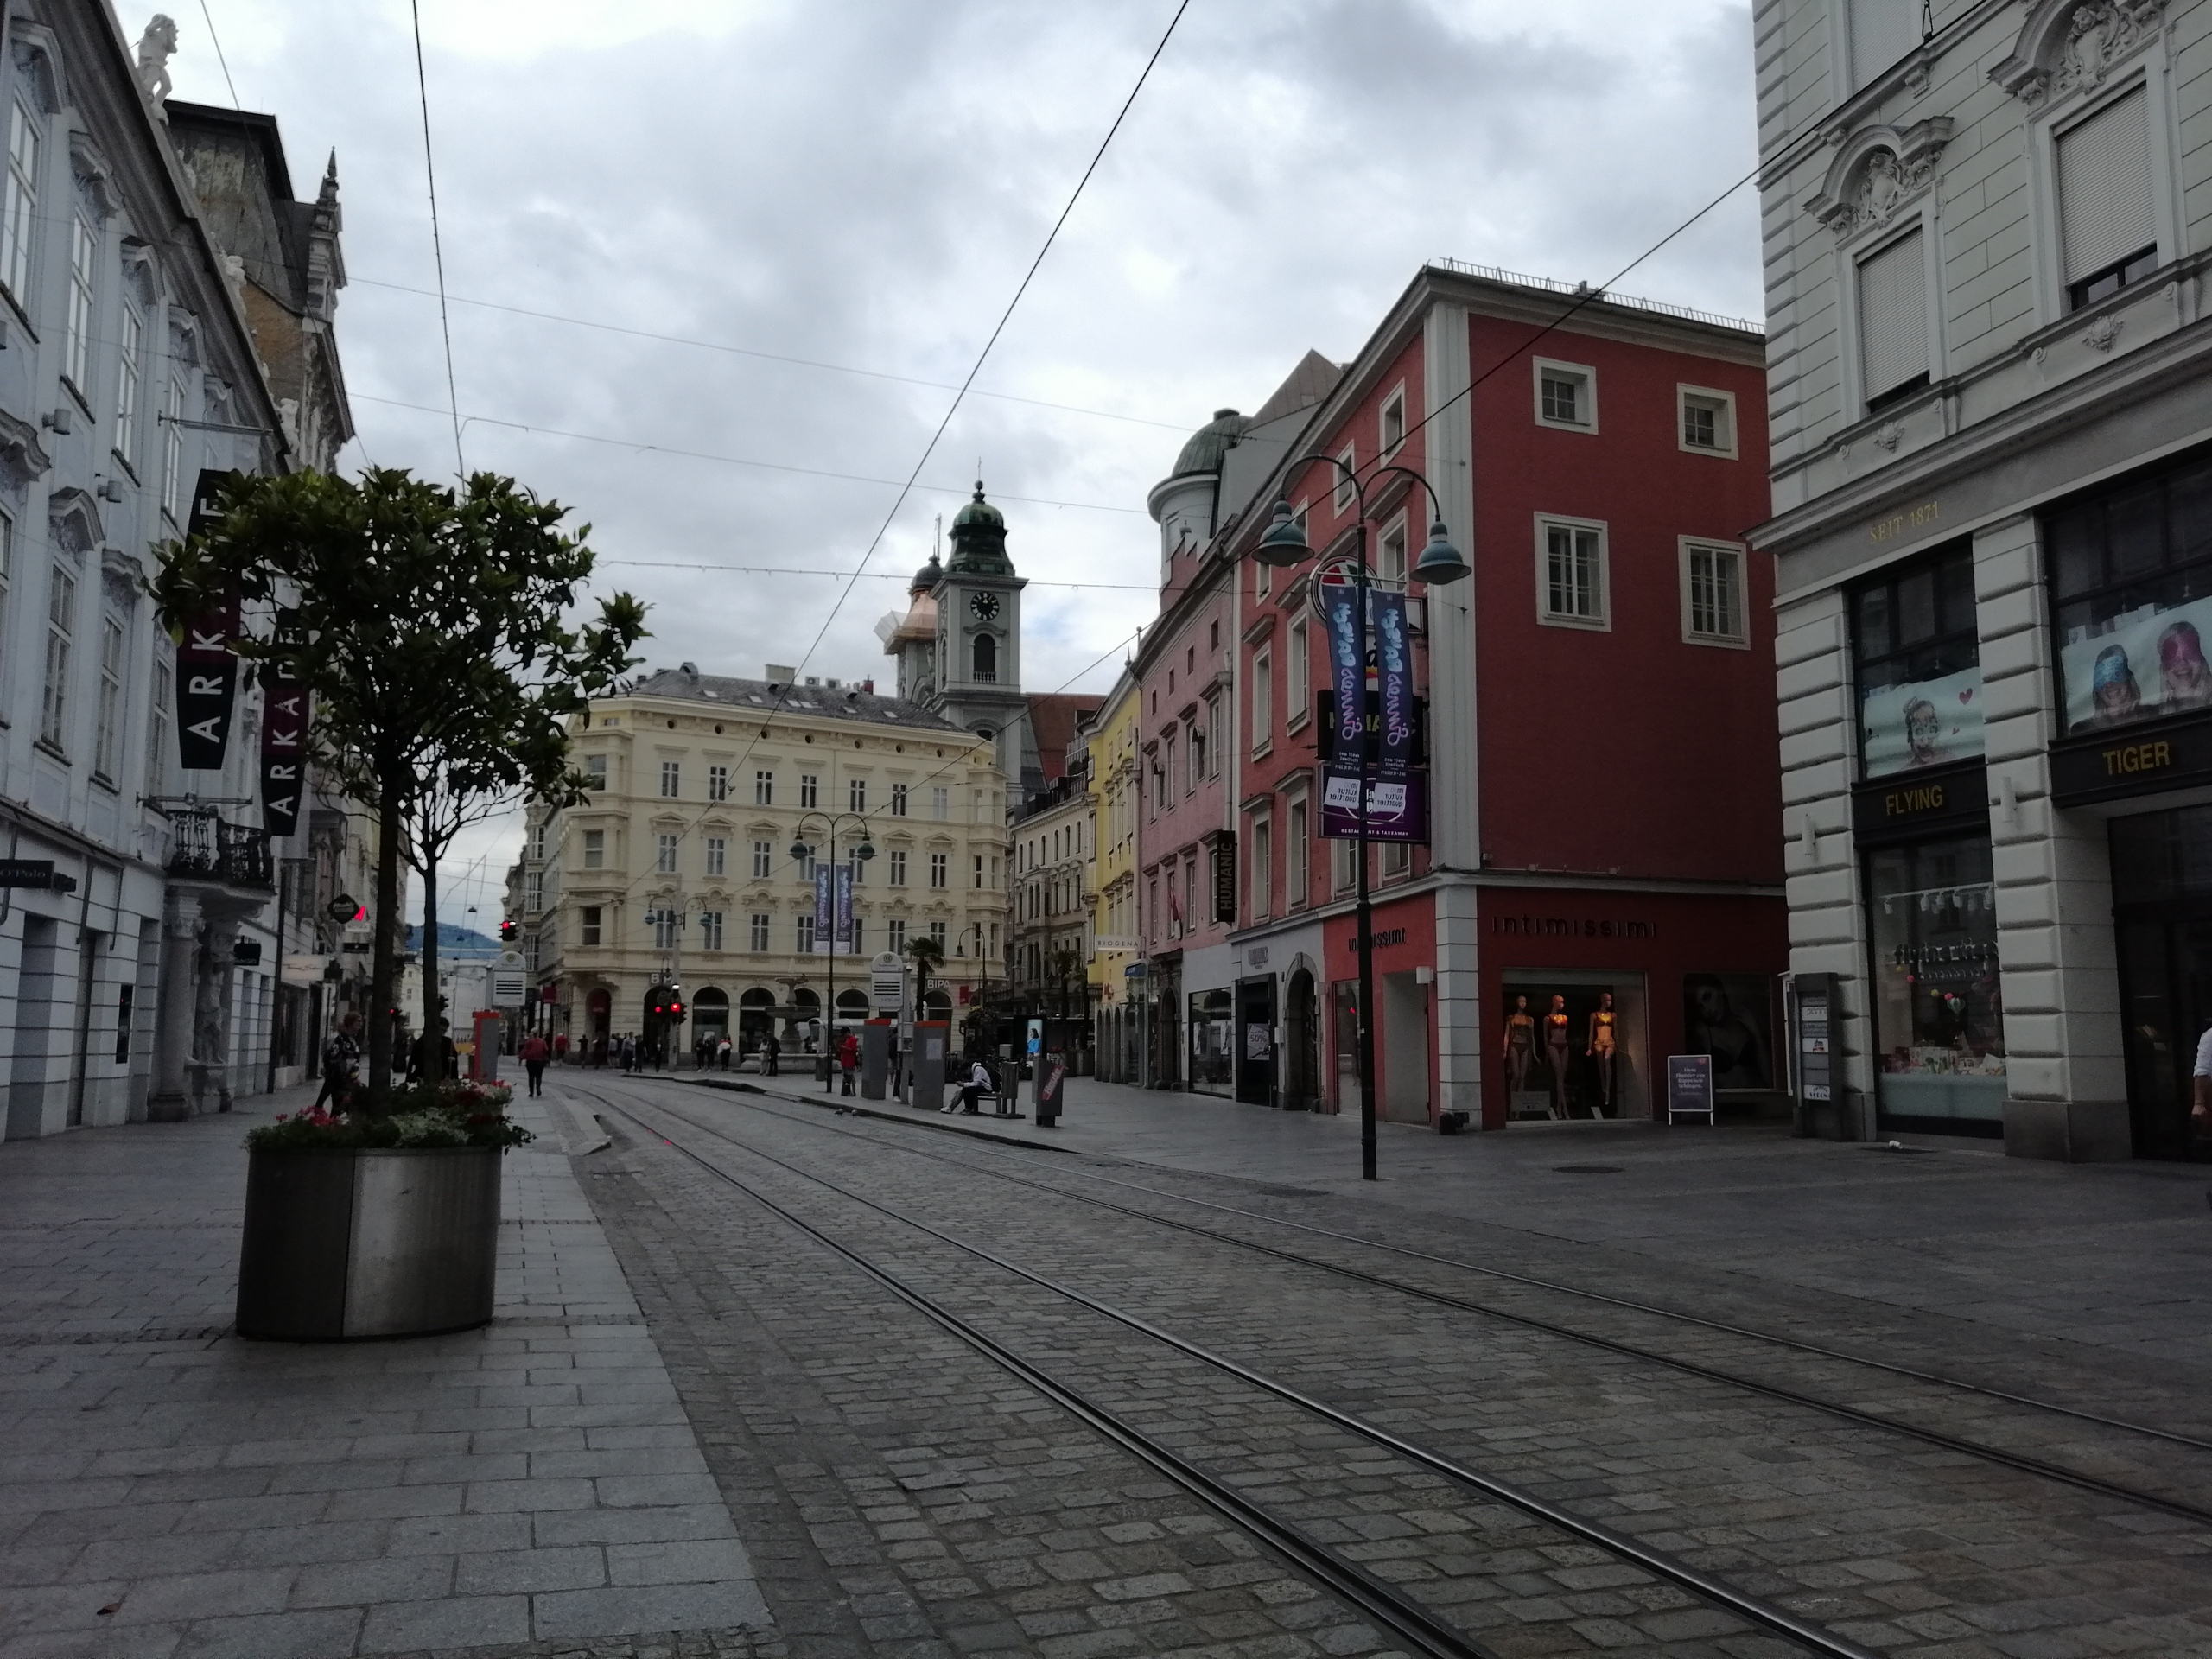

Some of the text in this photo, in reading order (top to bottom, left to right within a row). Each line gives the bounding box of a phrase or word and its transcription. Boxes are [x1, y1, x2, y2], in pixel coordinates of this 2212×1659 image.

[1870, 501, 1939, 544] SEIT 1871
[2101, 741, 2171, 776] TIGER
[1885, 785, 1944, 817] FLYING
[1220, 842, 1233, 911] HUMANIC
[1348, 927, 1407, 952] inissimi
[1492, 913, 1656, 937] intimissimi
[927, 979, 950, 989] BIPA
